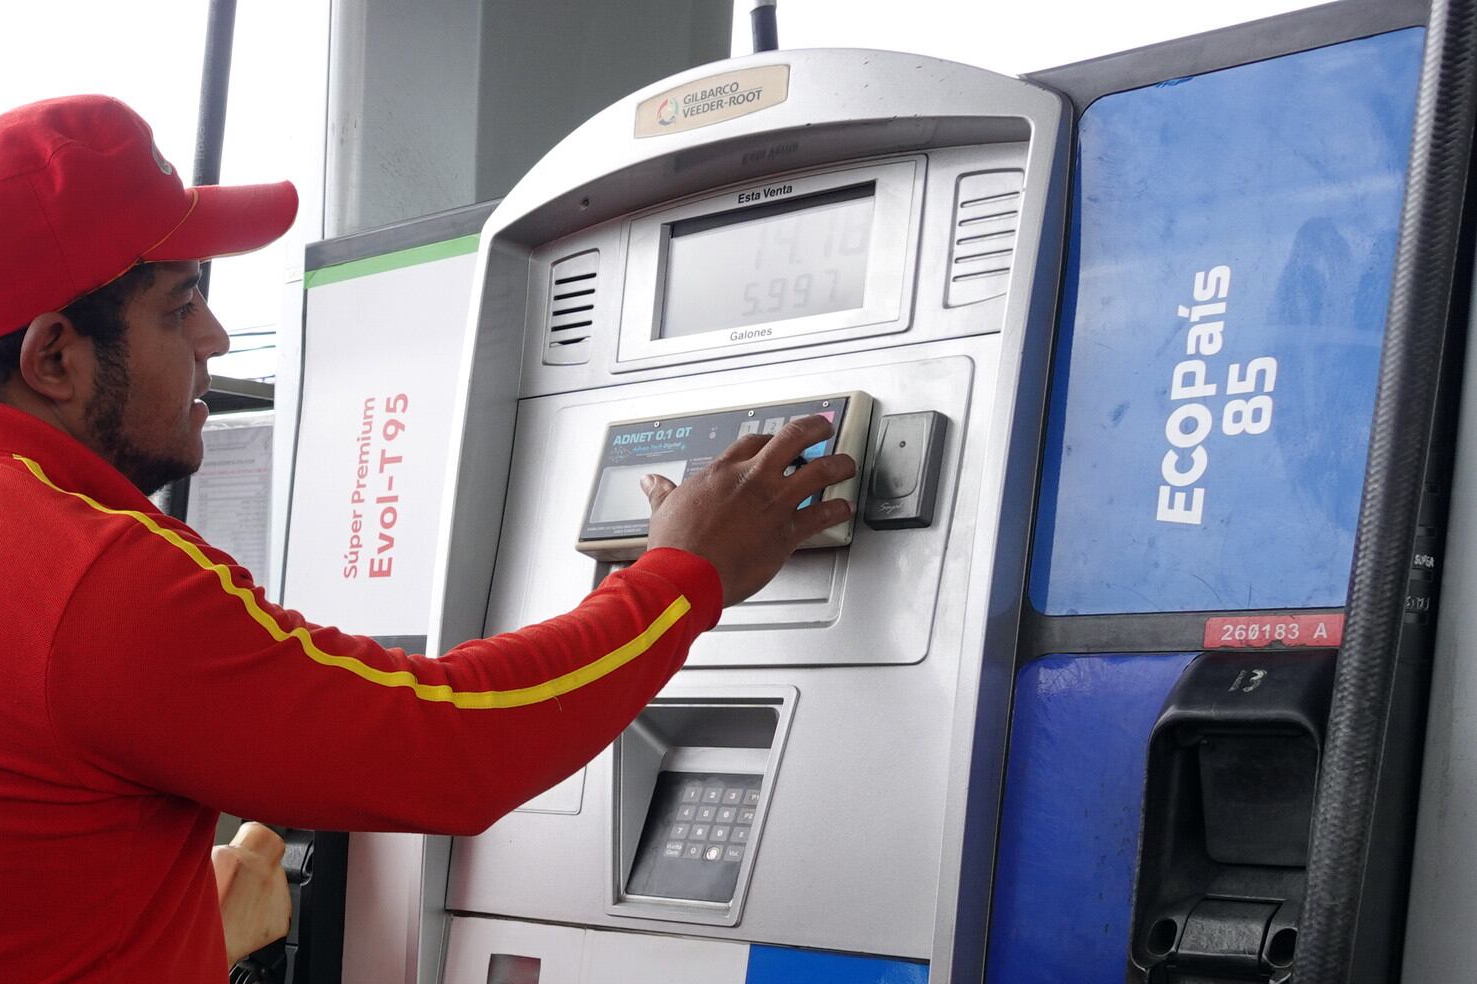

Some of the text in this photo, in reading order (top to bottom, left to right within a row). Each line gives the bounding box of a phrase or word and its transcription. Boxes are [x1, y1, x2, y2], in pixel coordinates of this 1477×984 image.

[682, 89, 763, 118] VEEDER-ROOT
[683, 82, 739, 105] GILBARCO
[738, 184, 793, 204] Esta Venta
[730, 327, 773, 342] Galones
[1156, 264, 1231, 525] ECOPaís
[1221, 356, 1277, 436] 85
[613, 431, 655, 446] ADNET
[655, 429, 674, 441] 0.1
[344, 397, 376, 579] Súper Premium
[1220, 623, 1328, 642] 260183 A
